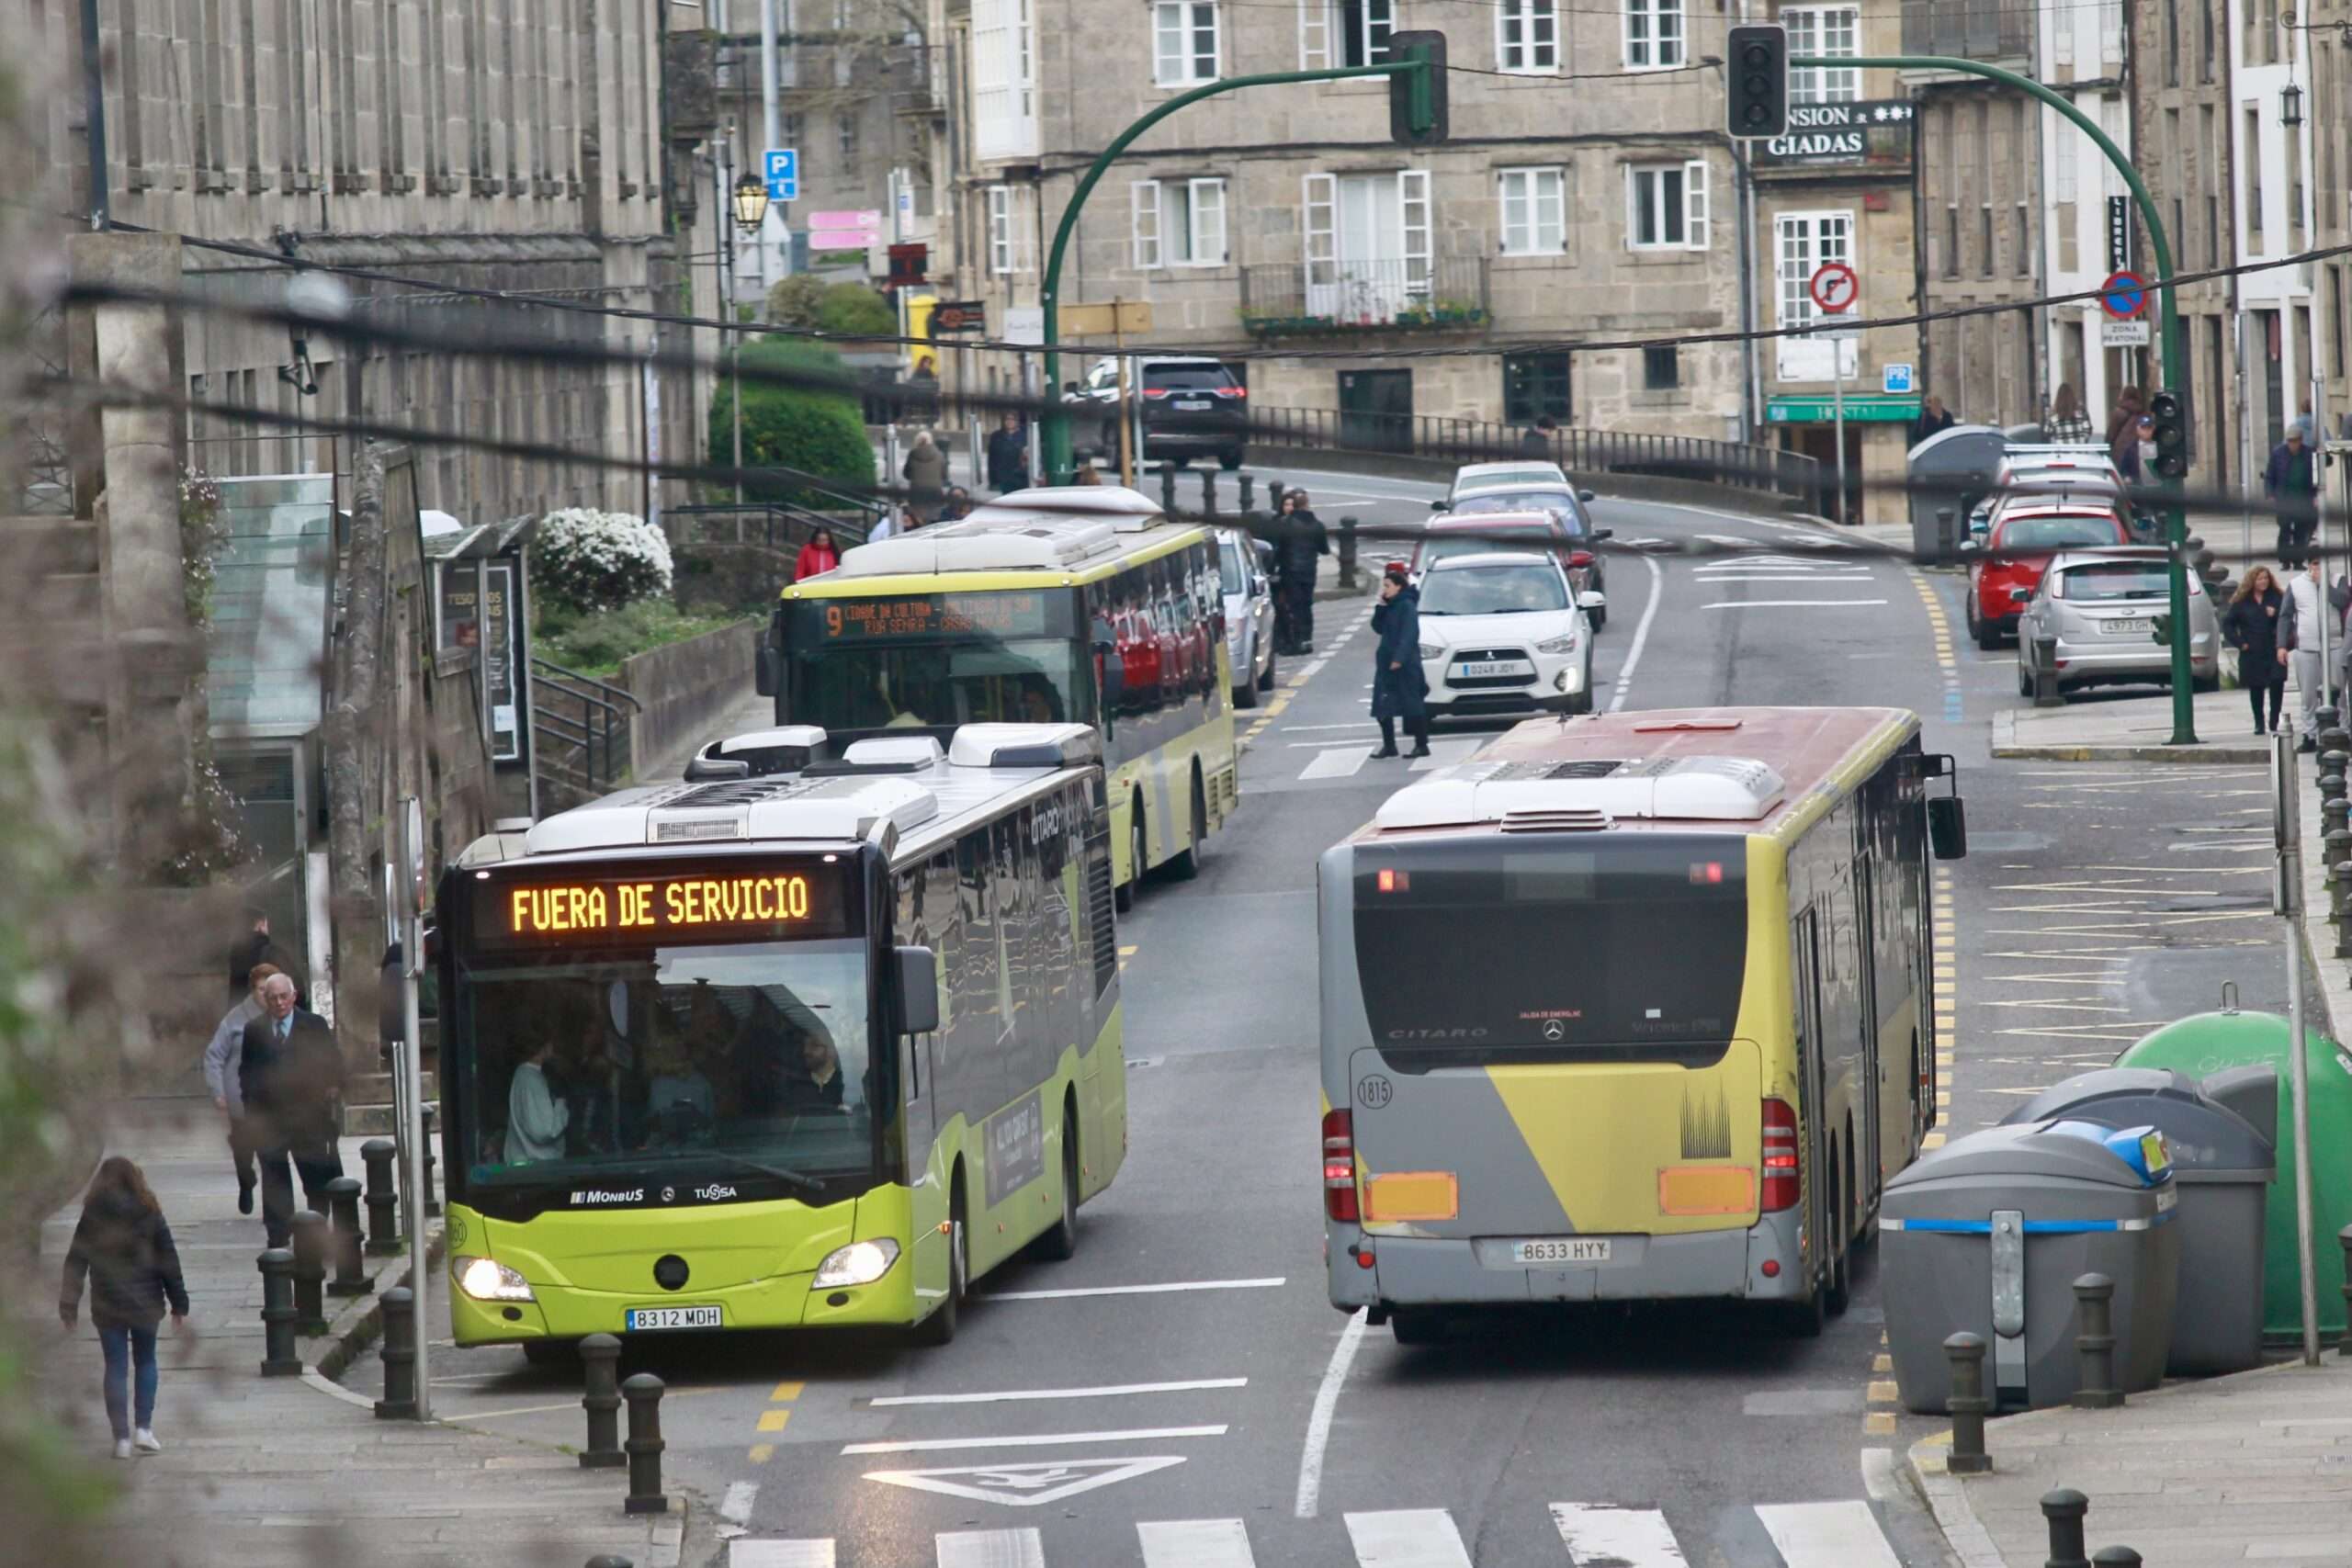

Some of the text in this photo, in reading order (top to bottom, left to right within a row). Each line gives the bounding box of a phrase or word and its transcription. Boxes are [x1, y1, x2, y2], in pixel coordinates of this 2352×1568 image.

[1768, 132, 1862, 155] GIADAS
[772, 155, 788, 175] P
[826, 605, 842, 637] 9
[513, 877, 807, 931] FUERA DE SERVICIO
[1388, 1028, 1488, 1039] CITARO
[1362, 1081, 1388, 1101] 1815
[1524, 1242, 1605, 1259] 8633 HYY
[638, 1308, 717, 1326] 8312 MDH
